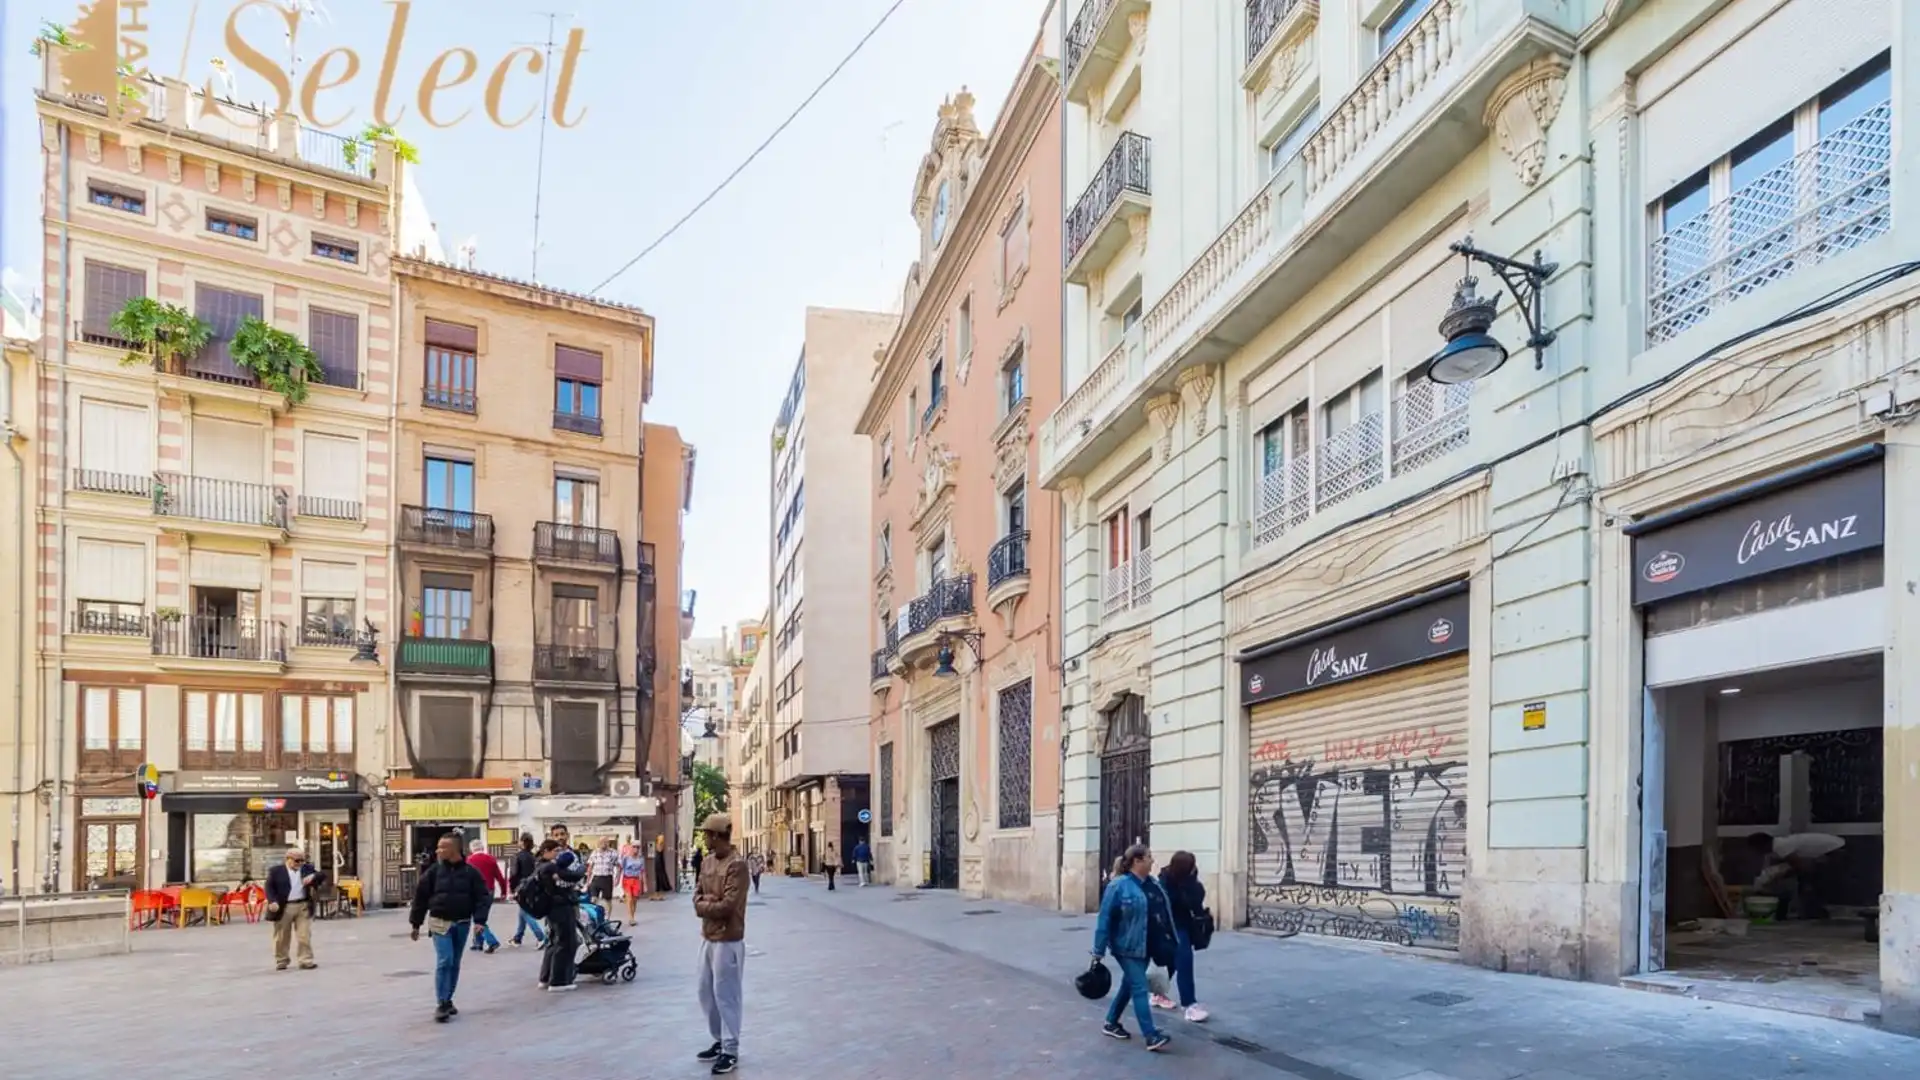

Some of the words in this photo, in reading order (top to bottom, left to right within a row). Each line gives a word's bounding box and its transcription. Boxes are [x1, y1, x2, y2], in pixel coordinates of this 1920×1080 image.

[1737, 513, 1795, 565] Casa
[1784, 514, 1858, 552] SANZ
[1306, 644, 1336, 685] Casa
[1331, 652, 1368, 678] SANZ
